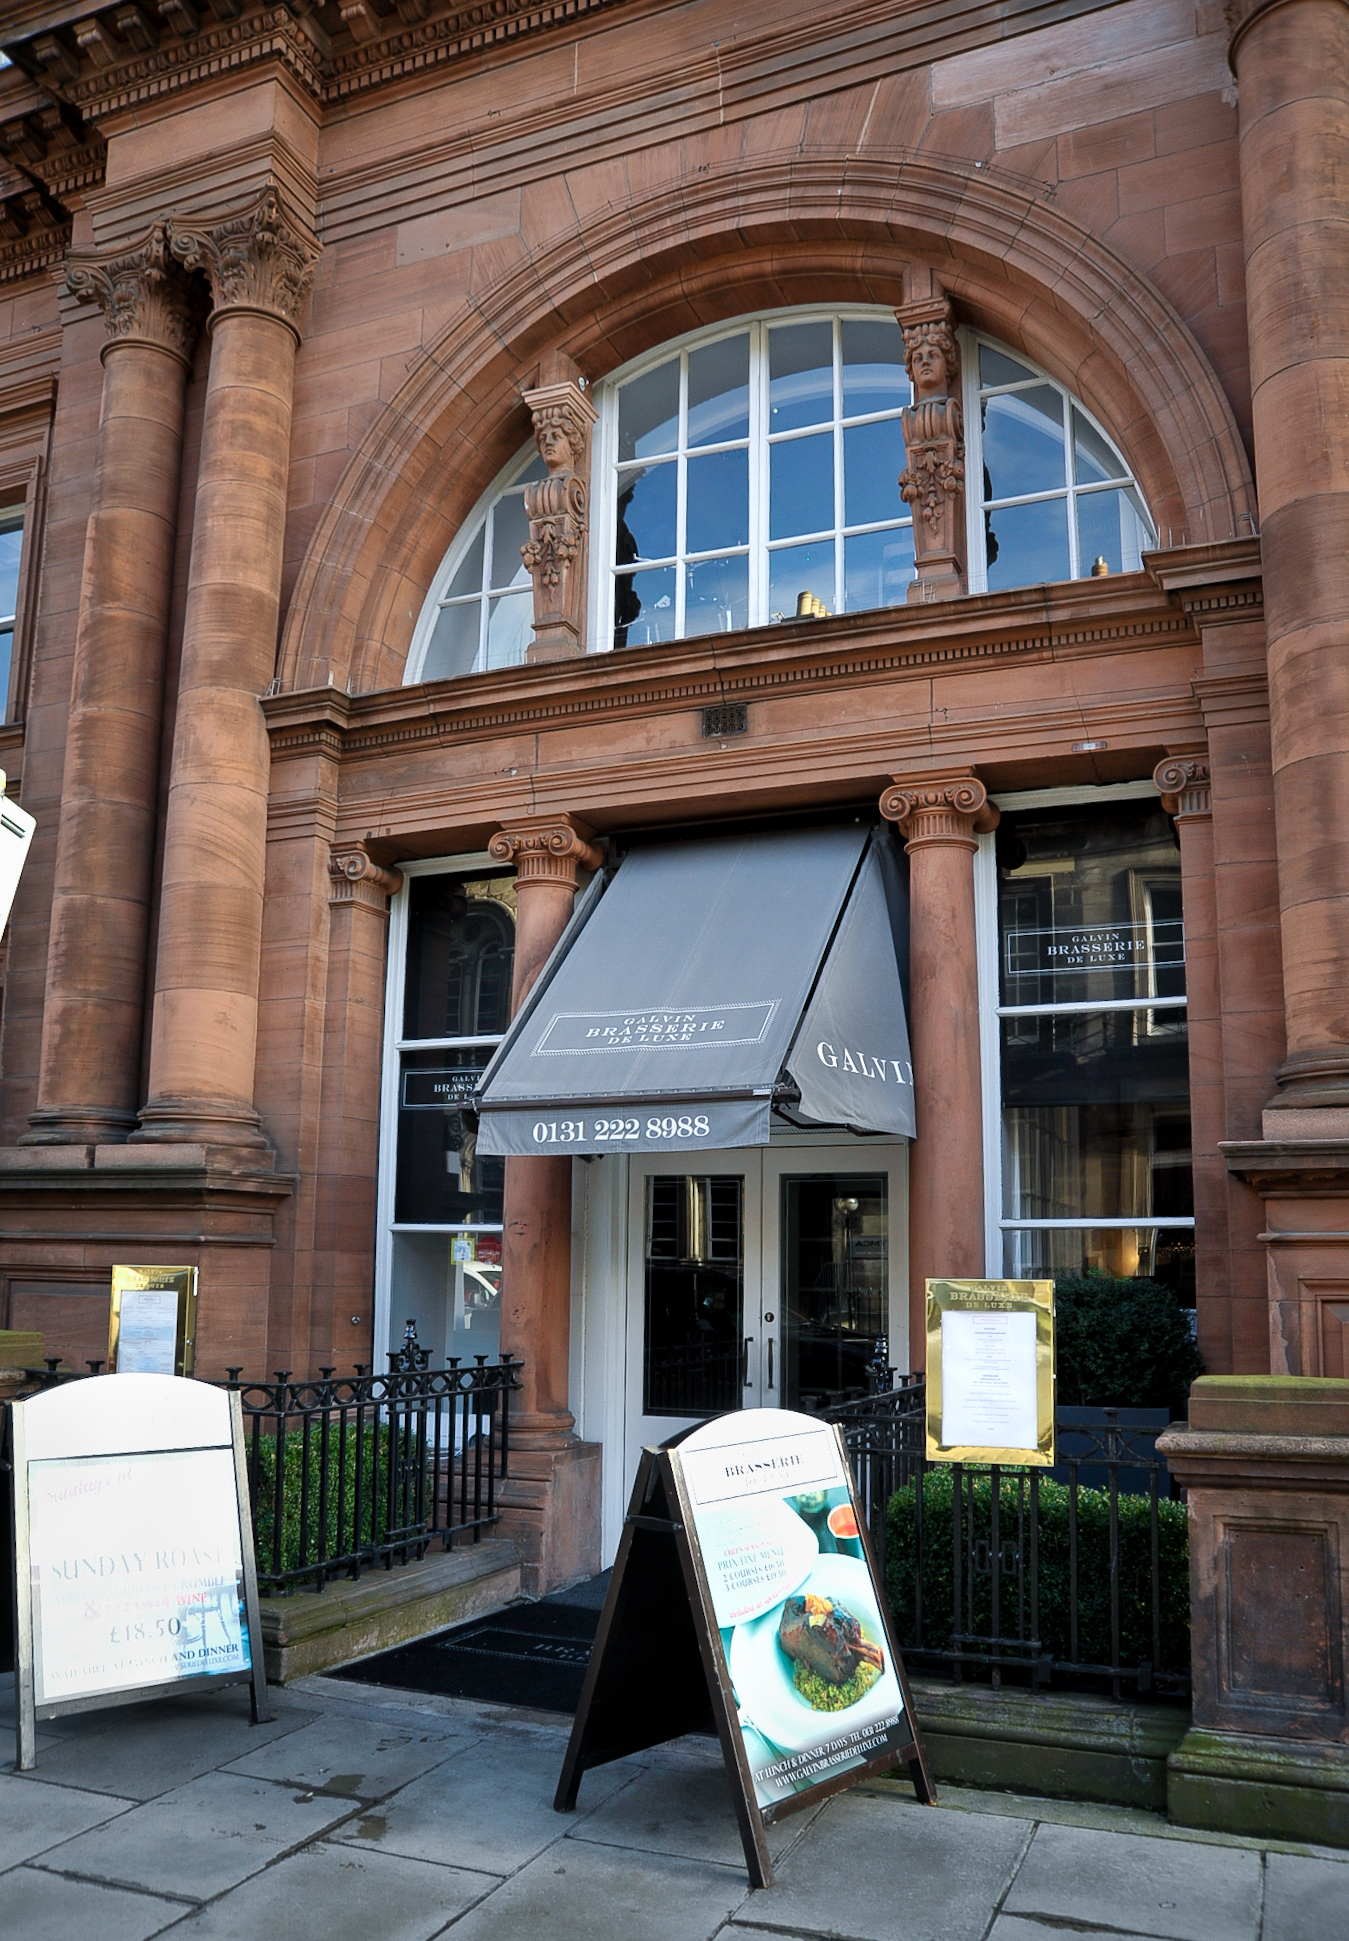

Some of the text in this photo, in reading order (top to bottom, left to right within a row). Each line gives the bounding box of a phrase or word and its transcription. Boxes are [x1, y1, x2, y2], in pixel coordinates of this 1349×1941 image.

[1072, 933, 1120, 943] GALVIN
[1047, 940, 1145, 956] BRASSERIE
[1067, 953, 1126, 964] DE LUXE
[623, 1014, 697, 1025] GALVIN
[585, 1020, 725, 1037] BRASSERIE
[607, 1033, 693, 1045] DE LUXE
[434, 1083, 476, 1092] BRASS
[532, 1115, 711, 1143] 0131 222 8988
[52, 1552, 146, 1580] SUNDAY
[176, 1591, 208, 1606] WINE
[110, 1616, 182, 1643] £18.50
[172, 1649, 195, 1661] AND
[198, 1643, 239, 1658] DINNER
[765, 1760, 791, 1778] LUNCH
[798, 1746, 826, 1765] DINNER
[875, 1720, 886, 1733] 222
